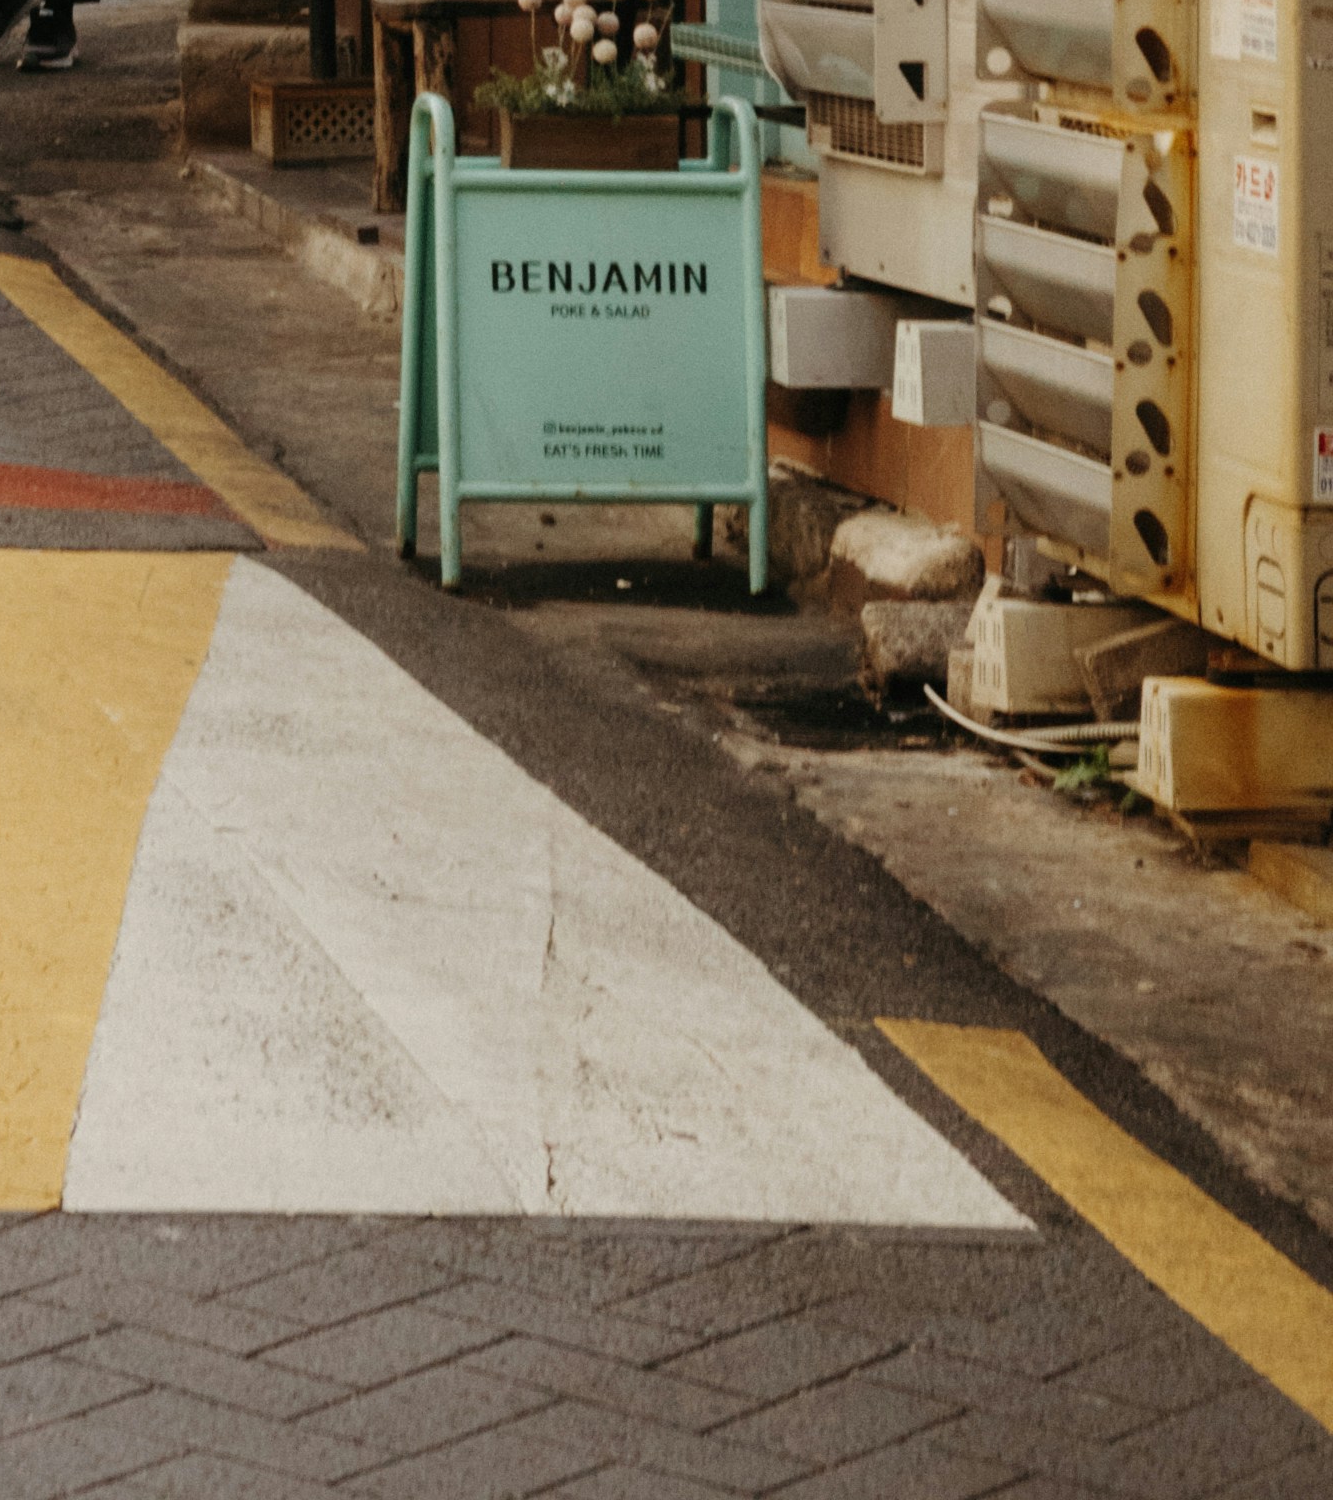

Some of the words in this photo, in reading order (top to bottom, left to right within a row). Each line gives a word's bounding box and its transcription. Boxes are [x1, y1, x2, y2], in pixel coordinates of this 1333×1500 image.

[491, 260, 708, 295] BENJAMIN
[551, 304, 585, 318] POKE
[591, 304, 601, 318] &
[605, 304, 651, 319] SALAD
[544, 443, 581, 459] EAT'S
[634, 444, 664, 460] TIME
